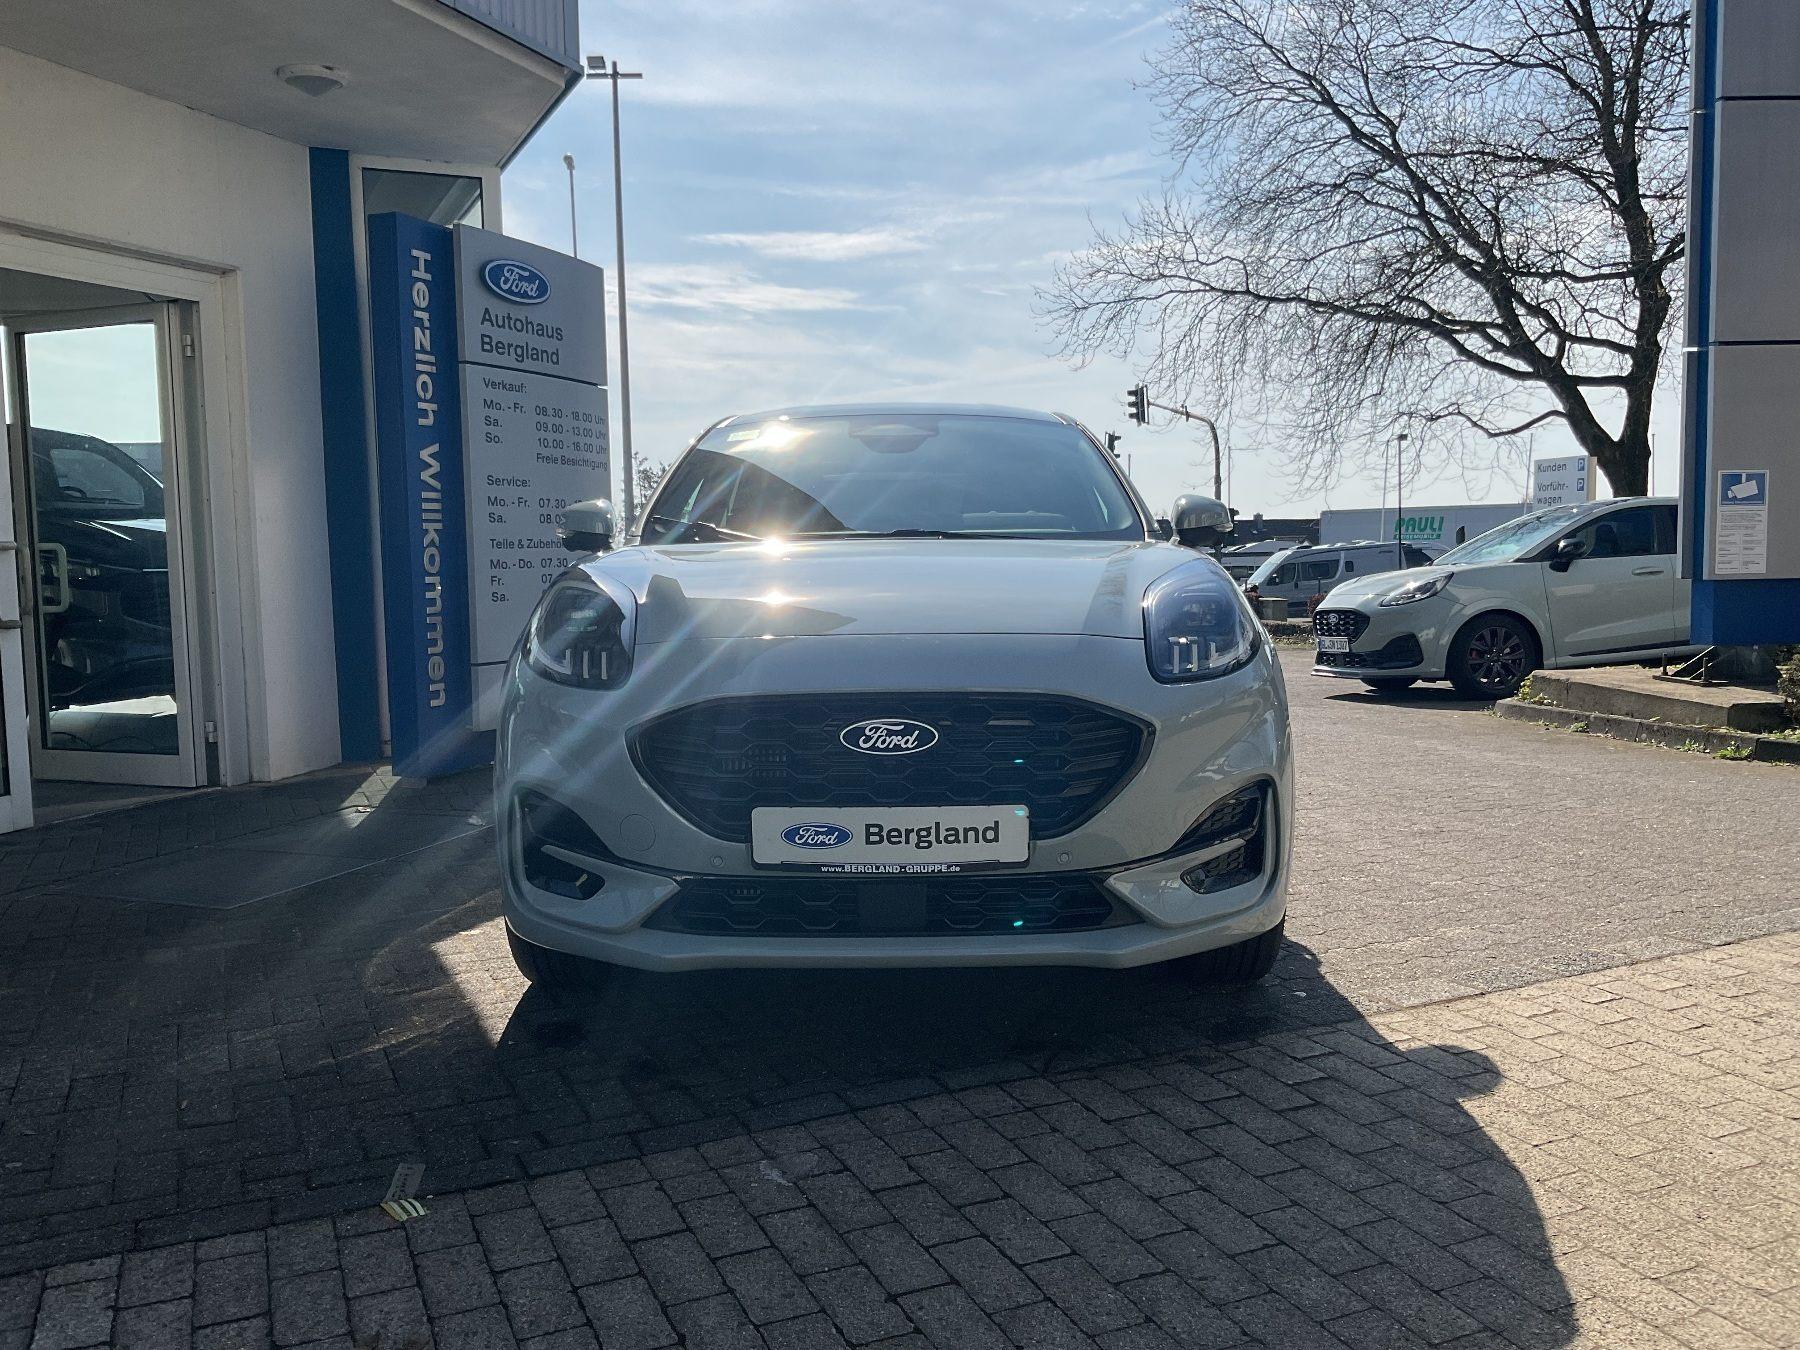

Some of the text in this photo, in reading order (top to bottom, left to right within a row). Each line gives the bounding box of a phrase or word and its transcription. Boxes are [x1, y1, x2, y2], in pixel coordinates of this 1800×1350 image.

[500, 265, 540, 298] Ford
[480, 307, 564, 342] Autohaus
[480, 333, 560, 366] Bergland
[482, 377, 527, 394] Verkauf:
[483, 398, 505, 412] Mo.
[513, 402, 527, 414] Fr.
[534, 405, 563, 419] 08.30
[571, 411, 592, 423] 18.00
[484, 415, 503, 428] Sa.
[535, 421, 564, 434] 09.00
[572, 426, 593, 438] 13.00
[485, 432, 503, 444] So.
[537, 437, 564, 450] 10.00
[536, 453, 608, 472] Freie Besichtigung
[1537, 463, 1567, 473] Kunden
[411, 248, 446, 708] Herzlich Willkommen
[486, 475, 531, 488] Service:
[1537, 481, 1569, 492] Vorführ-
[487, 496, 509, 507] Mo.
[517, 497, 530, 508] Fr.
[538, 497, 566, 509] 07.30
[1536, 496, 1562, 506] wagen
[488, 512, 506, 524] Sa.
[1394, 516, 1444, 533] PAULI
[490, 538, 515, 550] Teile
[517, 539, 525, 550] &
[490, 559, 511, 570] Mo.
[518, 559, 535, 569] Do.
[541, 558, 568, 568] 07.30
[490, 576, 505, 586] Fr.
[491, 592, 510, 603] Sa.
[859, 724, 919, 749] Ford
[795, 821, 1000, 849] Ford Bergland
[821, 864, 961, 873] www.BERGLAND-GRUPPE.de
